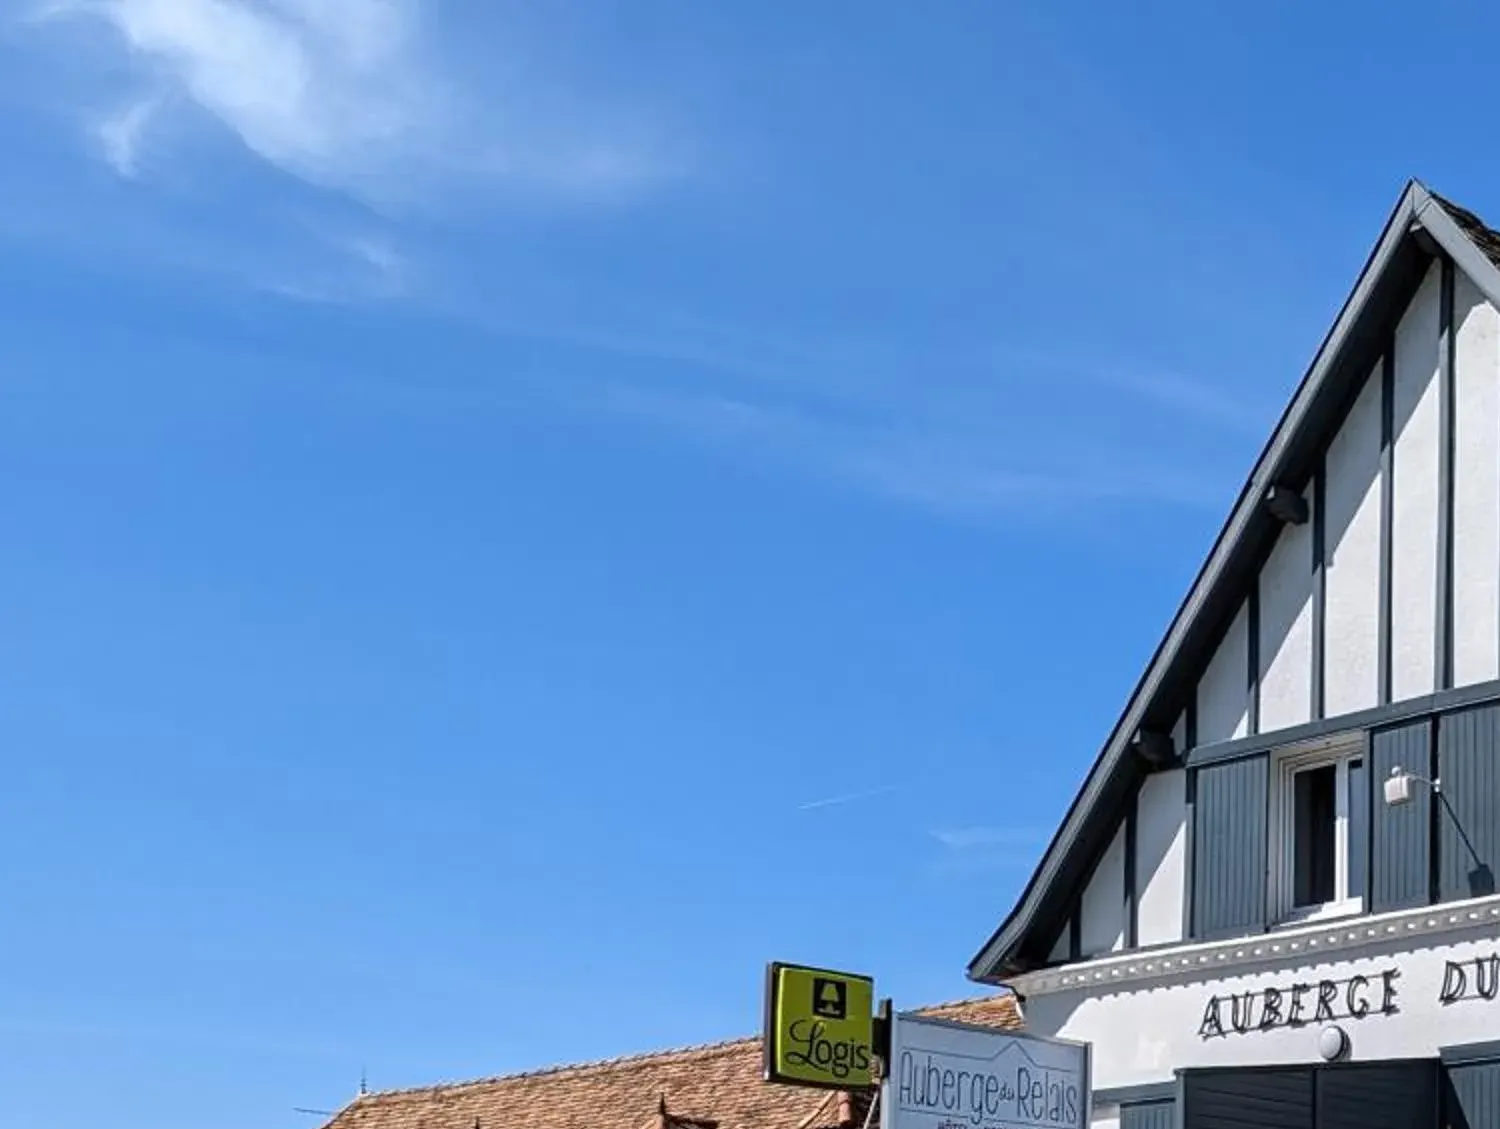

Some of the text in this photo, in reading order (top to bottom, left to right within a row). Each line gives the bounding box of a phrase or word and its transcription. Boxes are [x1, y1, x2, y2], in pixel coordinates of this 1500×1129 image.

[1198, 967, 1401, 1039] AUBERGE
[785, 1019, 870, 1078] Logis
[899, 1051, 1077, 1125] Auberge du Relais
